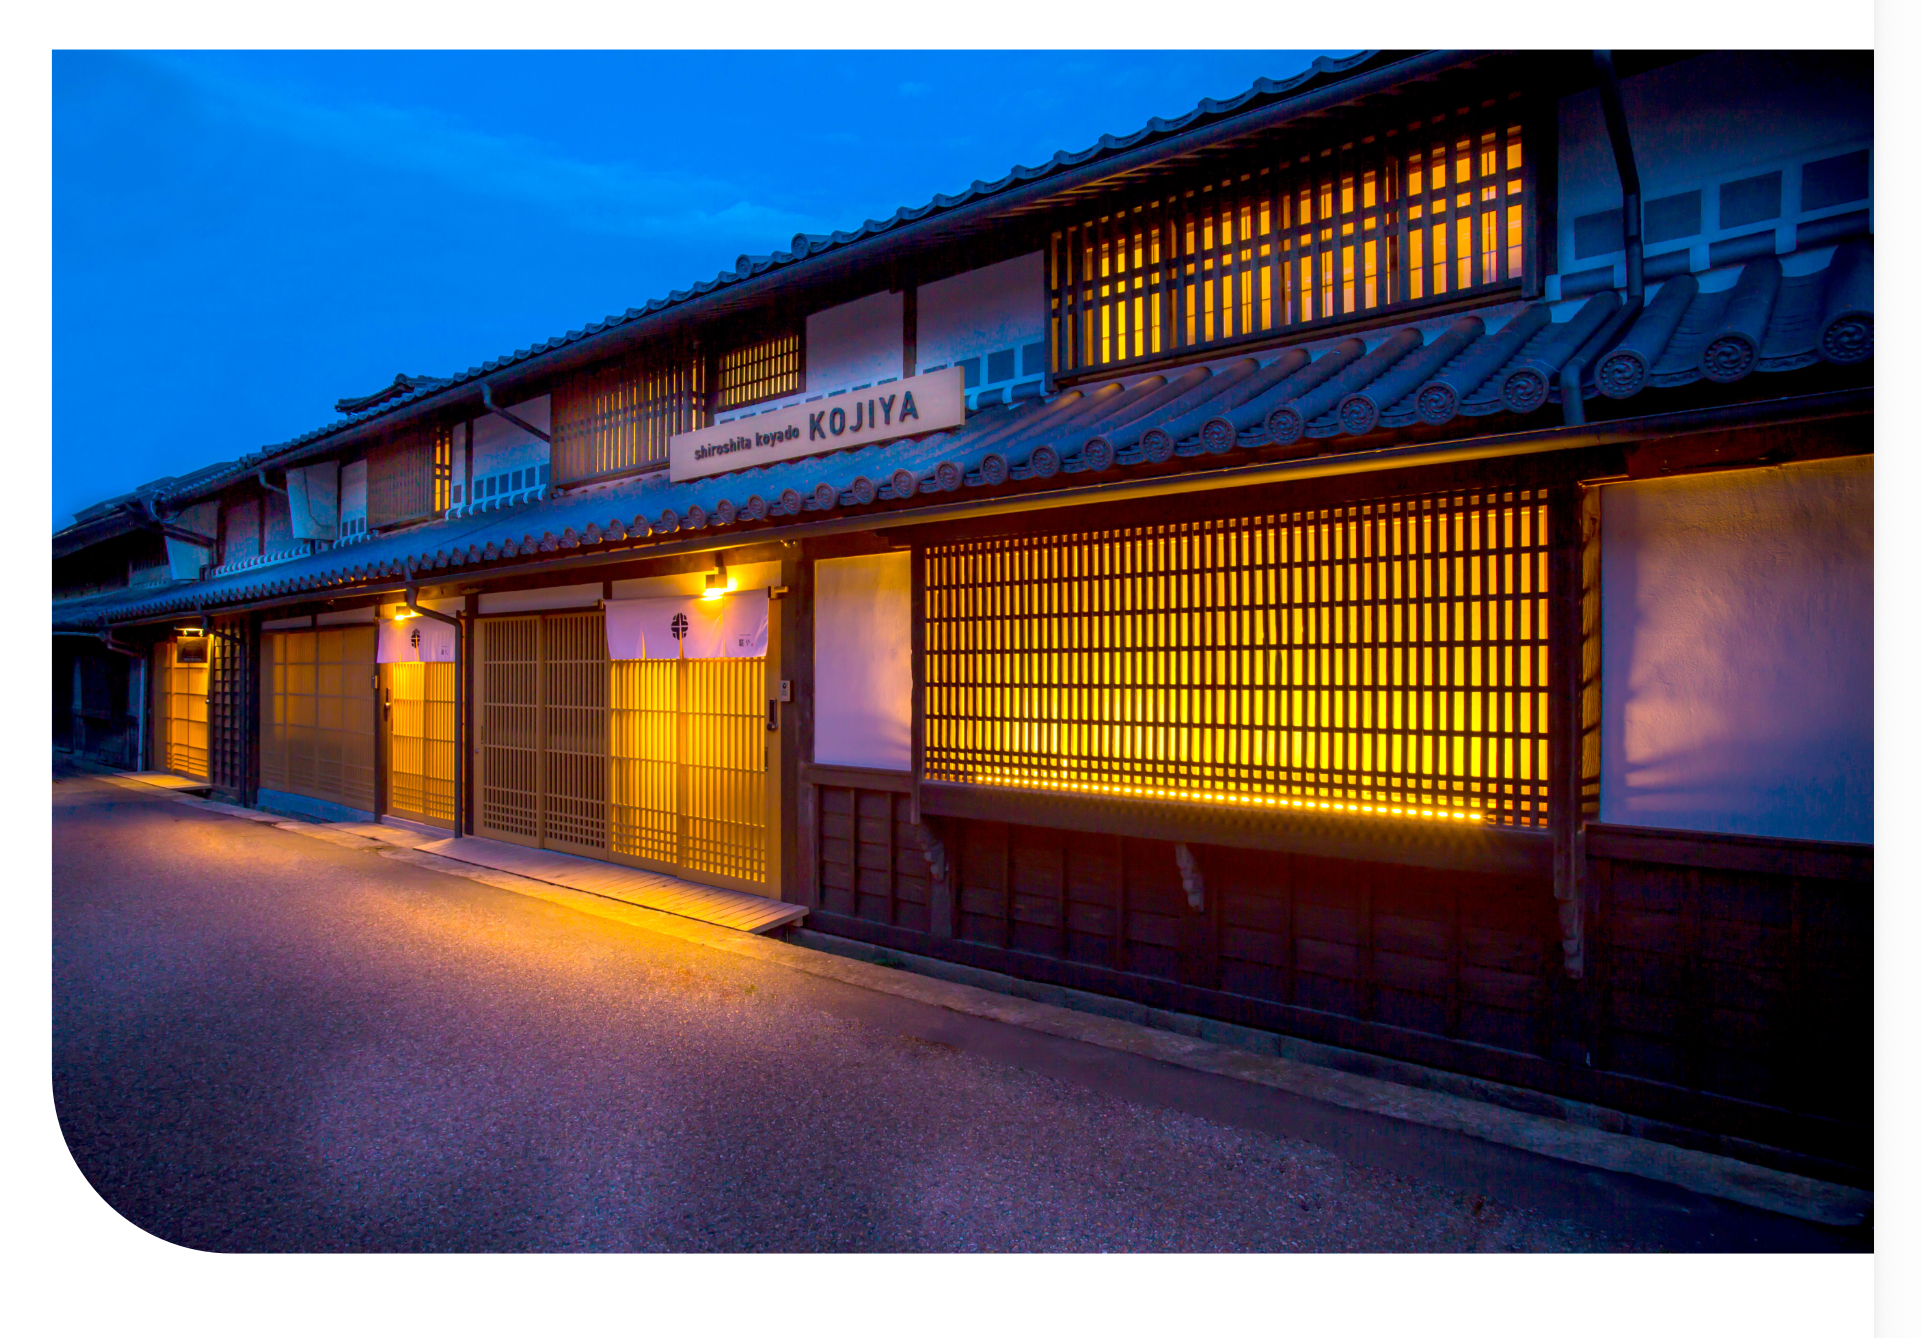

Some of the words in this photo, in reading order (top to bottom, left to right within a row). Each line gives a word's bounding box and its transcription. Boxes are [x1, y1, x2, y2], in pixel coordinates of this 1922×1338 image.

[695, 436, 752, 460] shiroshita
[755, 425, 800, 447] koyado
[809, 391, 919, 441] KOJIYA
